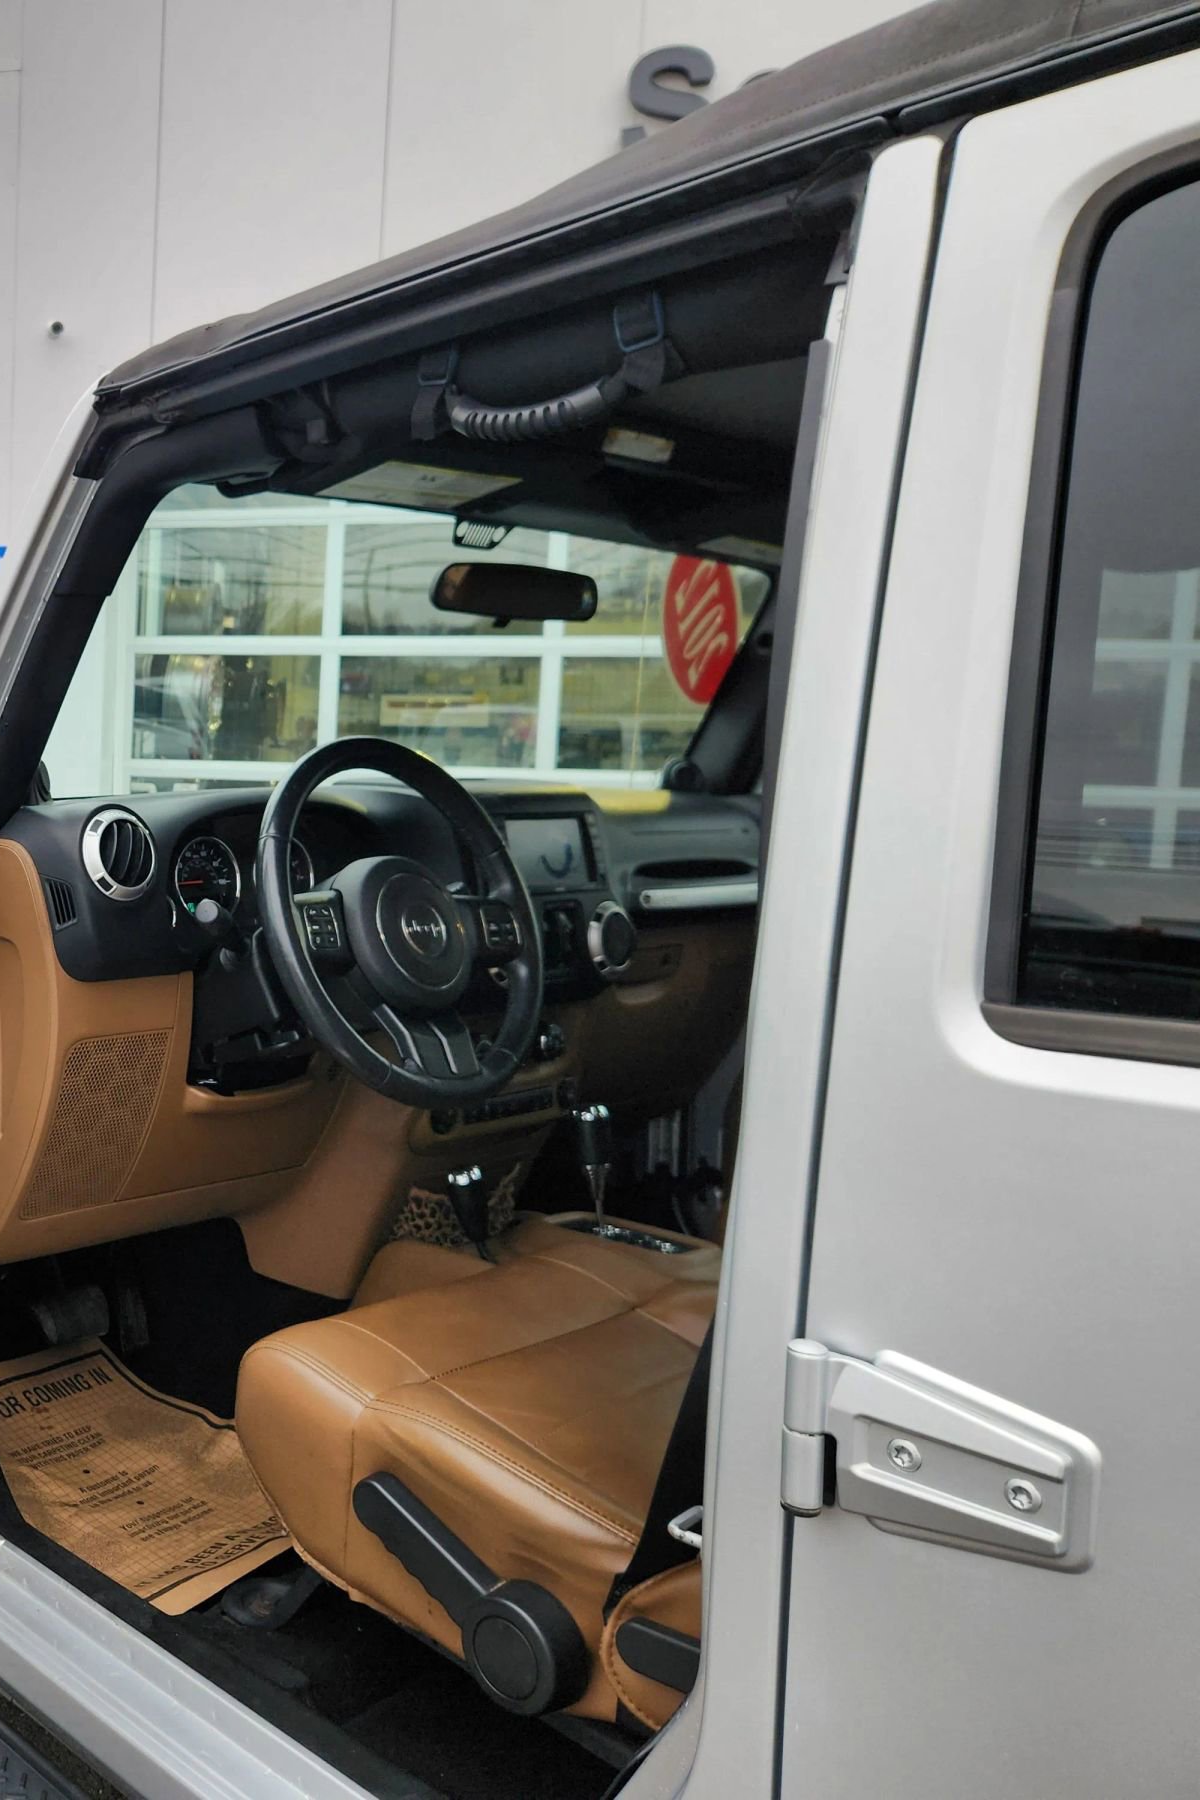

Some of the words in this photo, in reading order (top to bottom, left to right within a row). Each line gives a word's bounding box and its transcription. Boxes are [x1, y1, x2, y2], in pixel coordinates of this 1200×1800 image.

[22, 1373, 93, 1407] COMING
[87, 1366, 112, 1386] IN
[62, 1430, 75, 1441] TO
[184, 1541, 229, 1564] BEEN
